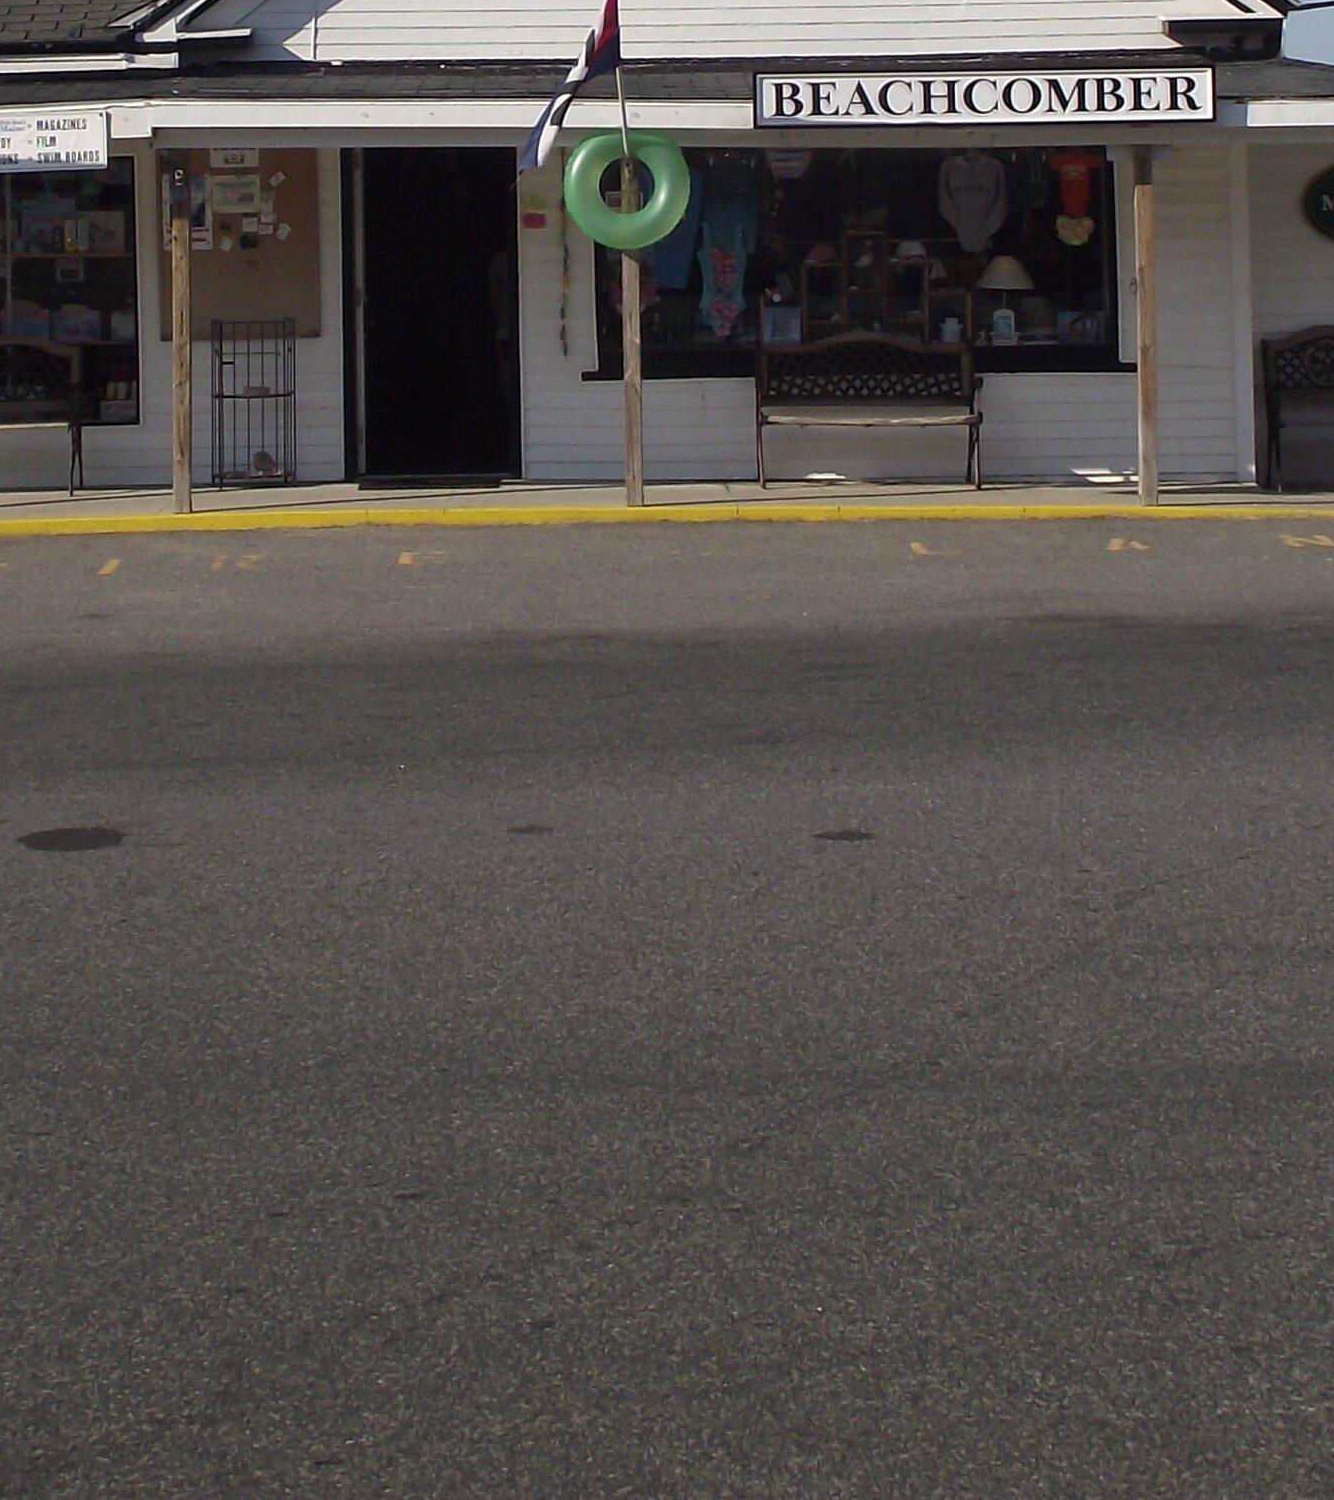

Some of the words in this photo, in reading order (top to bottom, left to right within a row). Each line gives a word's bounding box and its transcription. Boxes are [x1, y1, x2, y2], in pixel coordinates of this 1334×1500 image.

[771, 76, 1203, 118] BEACHCOMBER
[36, 118, 87, 131] MAGAZINES
[36, 135, 57, 148] FILM
[37, 151, 62, 164] SWIM
[65, 149, 100, 162] BOARDS
